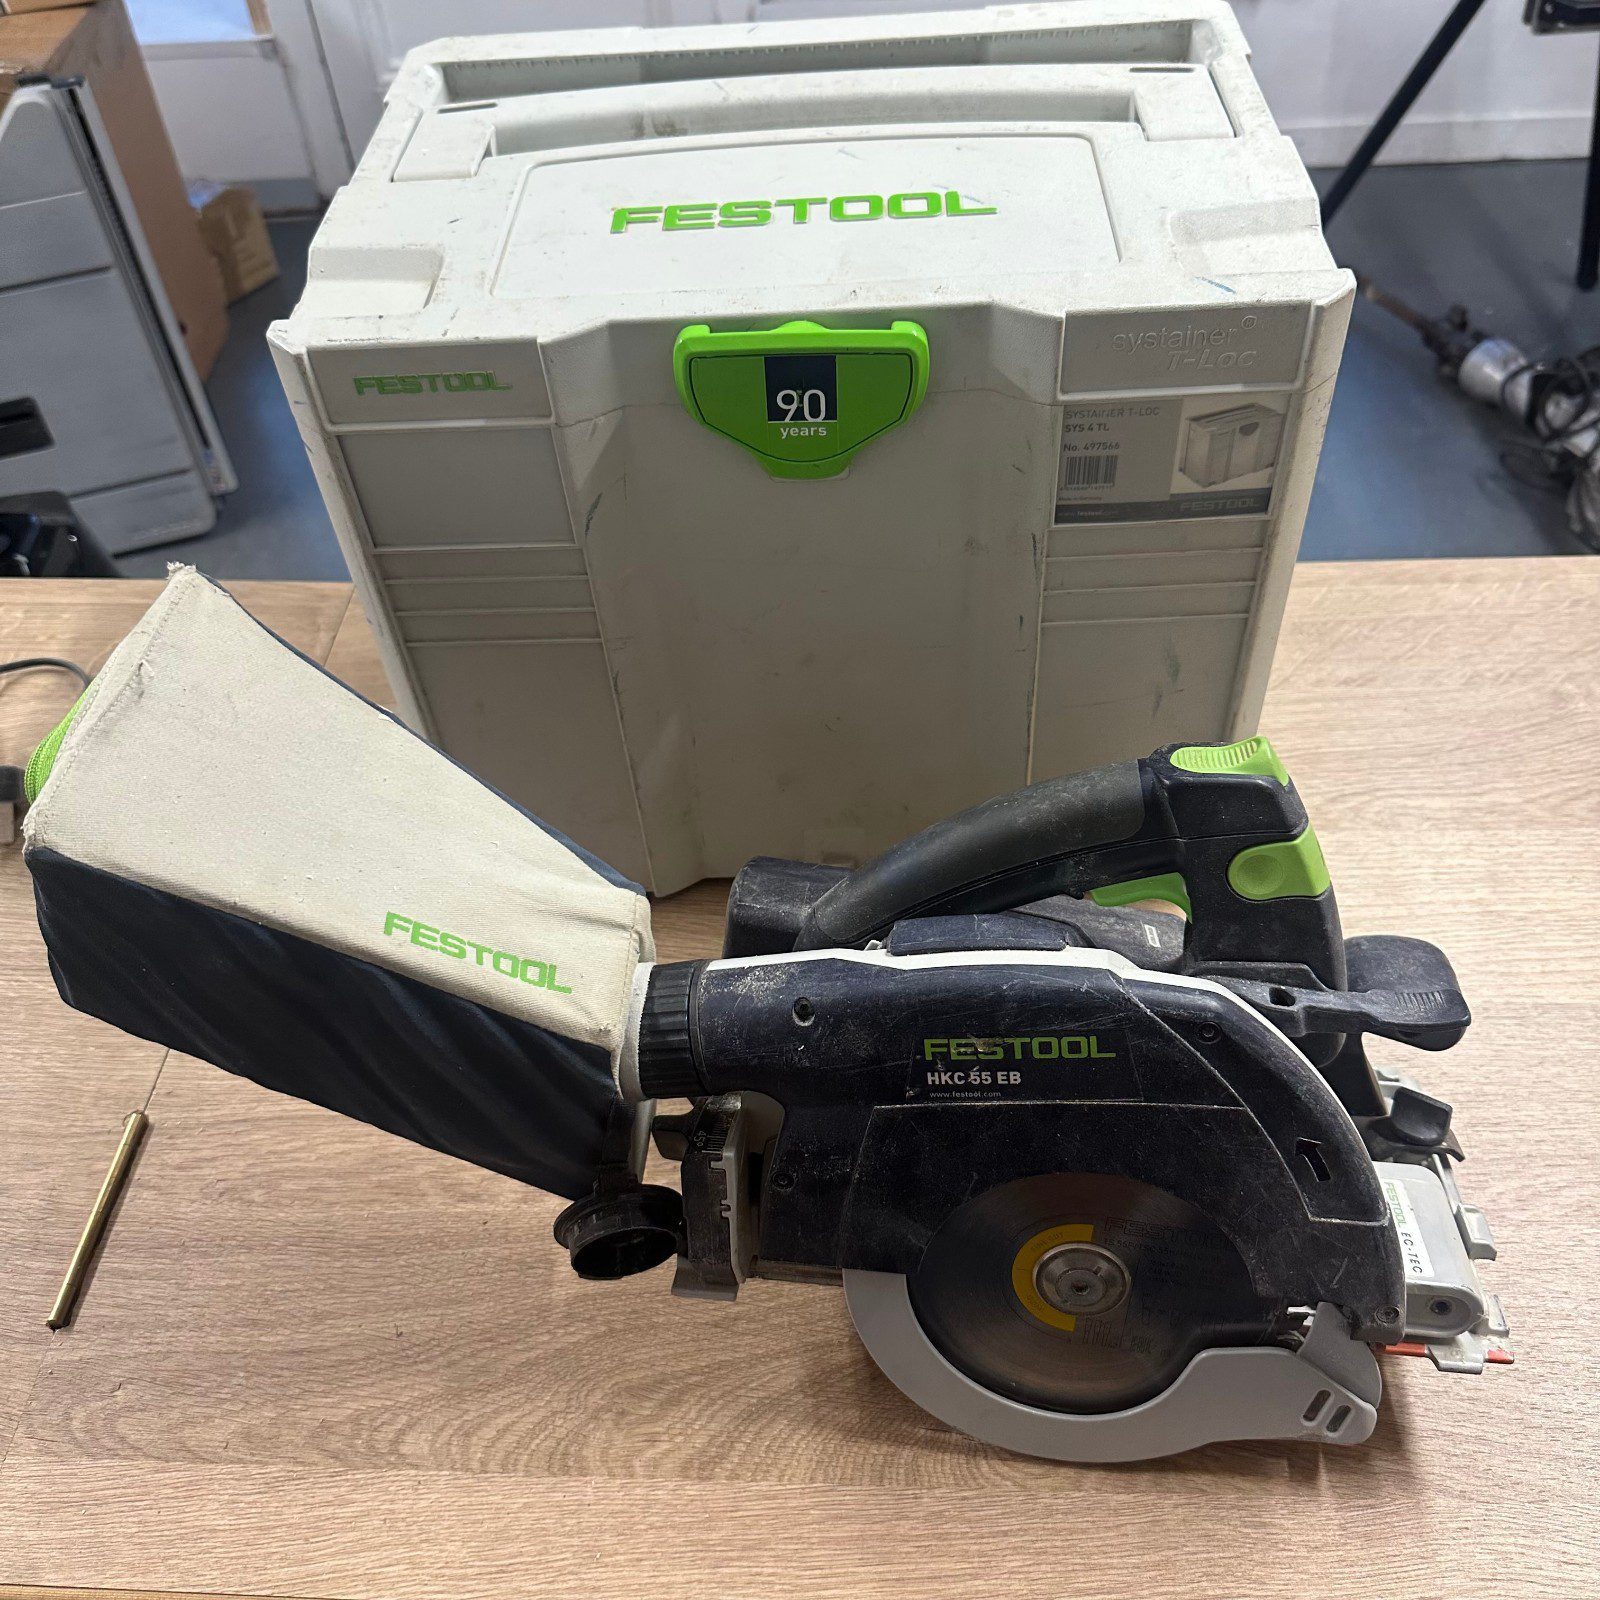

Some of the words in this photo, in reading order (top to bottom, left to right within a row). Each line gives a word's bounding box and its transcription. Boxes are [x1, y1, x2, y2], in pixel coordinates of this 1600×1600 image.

[609, 191, 998, 234] FESTOOL
[353, 370, 513, 396] FESTOOL
[776, 389, 826, 422] 90
[1065, 407, 1125, 420] SYSTAINER
[1128, 406, 1160, 417] T-LOC
[780, 427, 827, 439] years
[1065, 423, 1085, 433] SYS
[1087, 422, 1094, 432] 4
[1096, 422, 1110, 432] TL
[1063, 443, 1080, 452] No.
[1083, 441, 1120, 451] 497566
[1180, 497, 1260, 511] FESTOOL
[383, 911, 573, 995] FESTOOL
[923, 1035, 1117, 1060] FESTOOL
[927, 1071, 966, 1085] HKC
[970, 1071, 992, 1085] 55
[997, 1071, 1022, 1085] EB
[1383, 1181, 1407, 1228] FESTOOL
[1400, 1231, 1423, 1274] EC-TEC
